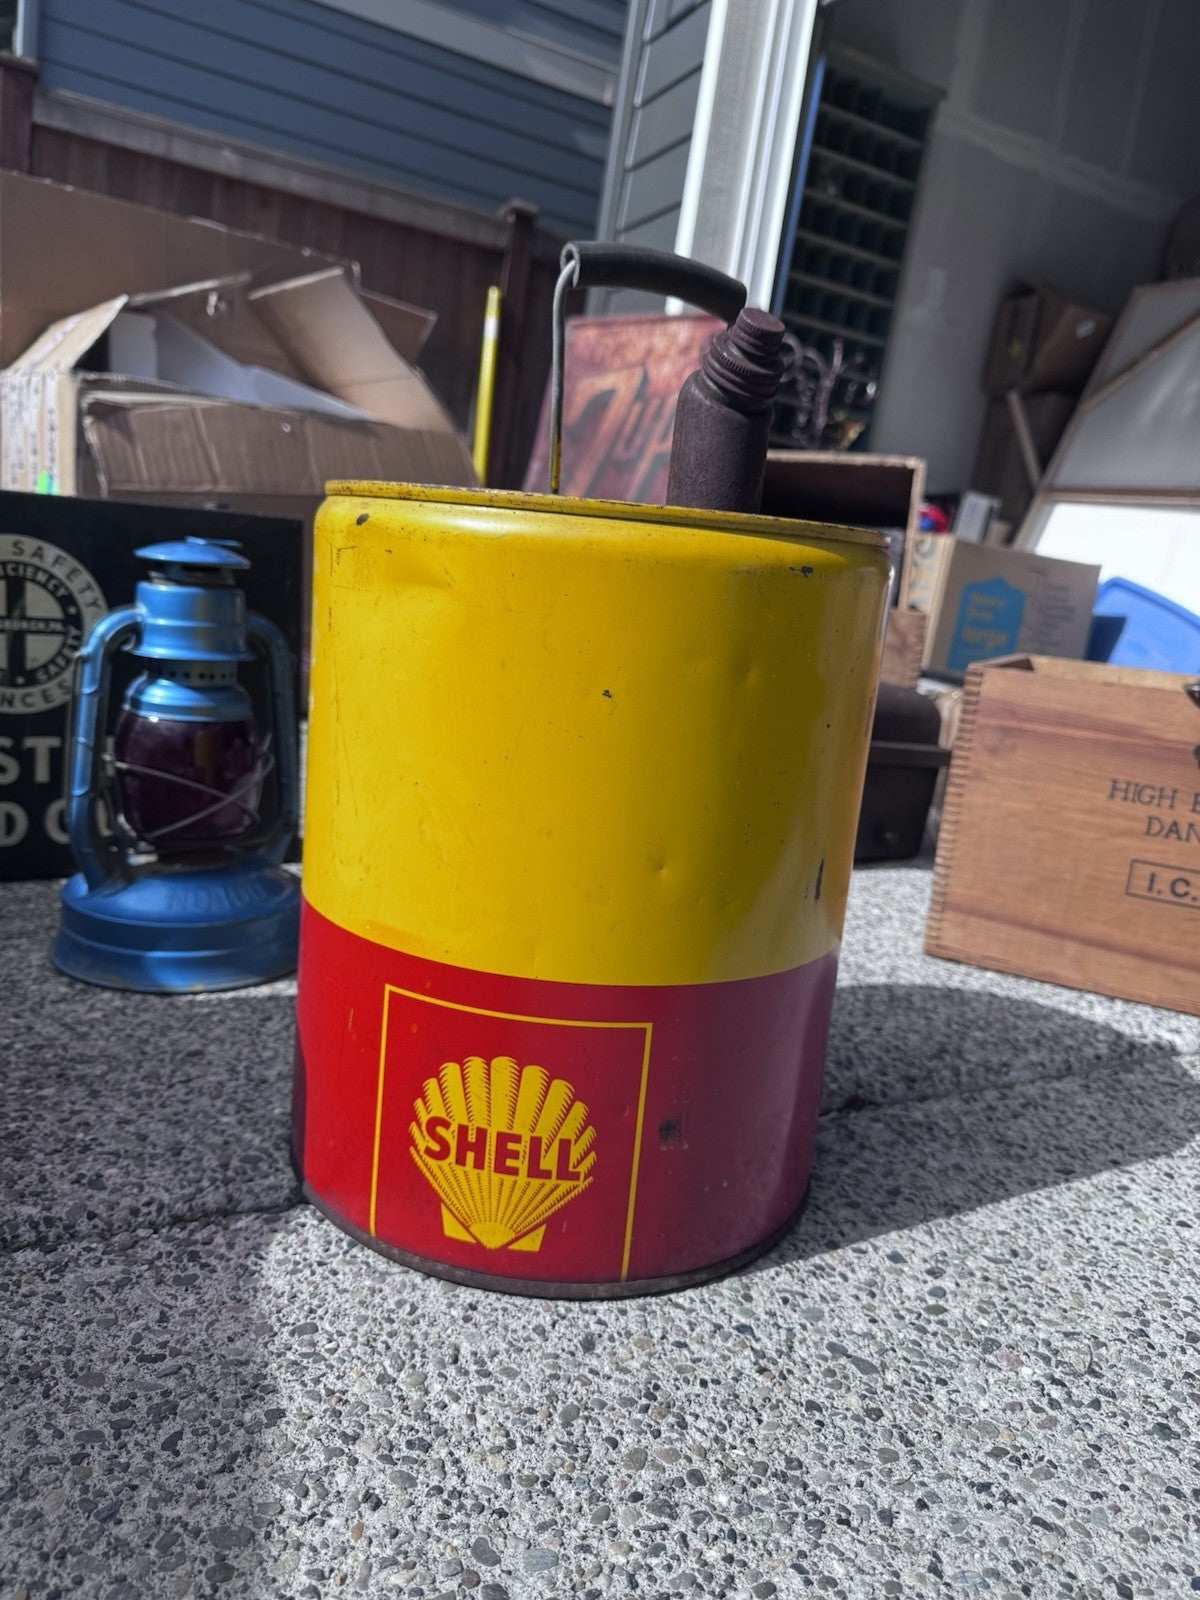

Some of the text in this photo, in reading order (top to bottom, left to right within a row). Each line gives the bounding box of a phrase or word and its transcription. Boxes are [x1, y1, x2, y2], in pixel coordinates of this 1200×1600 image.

[12, 540, 102, 609] SAFETY
[1107, 777, 1178, 811] HIGH
[424, 1116, 581, 1181] SHELL
